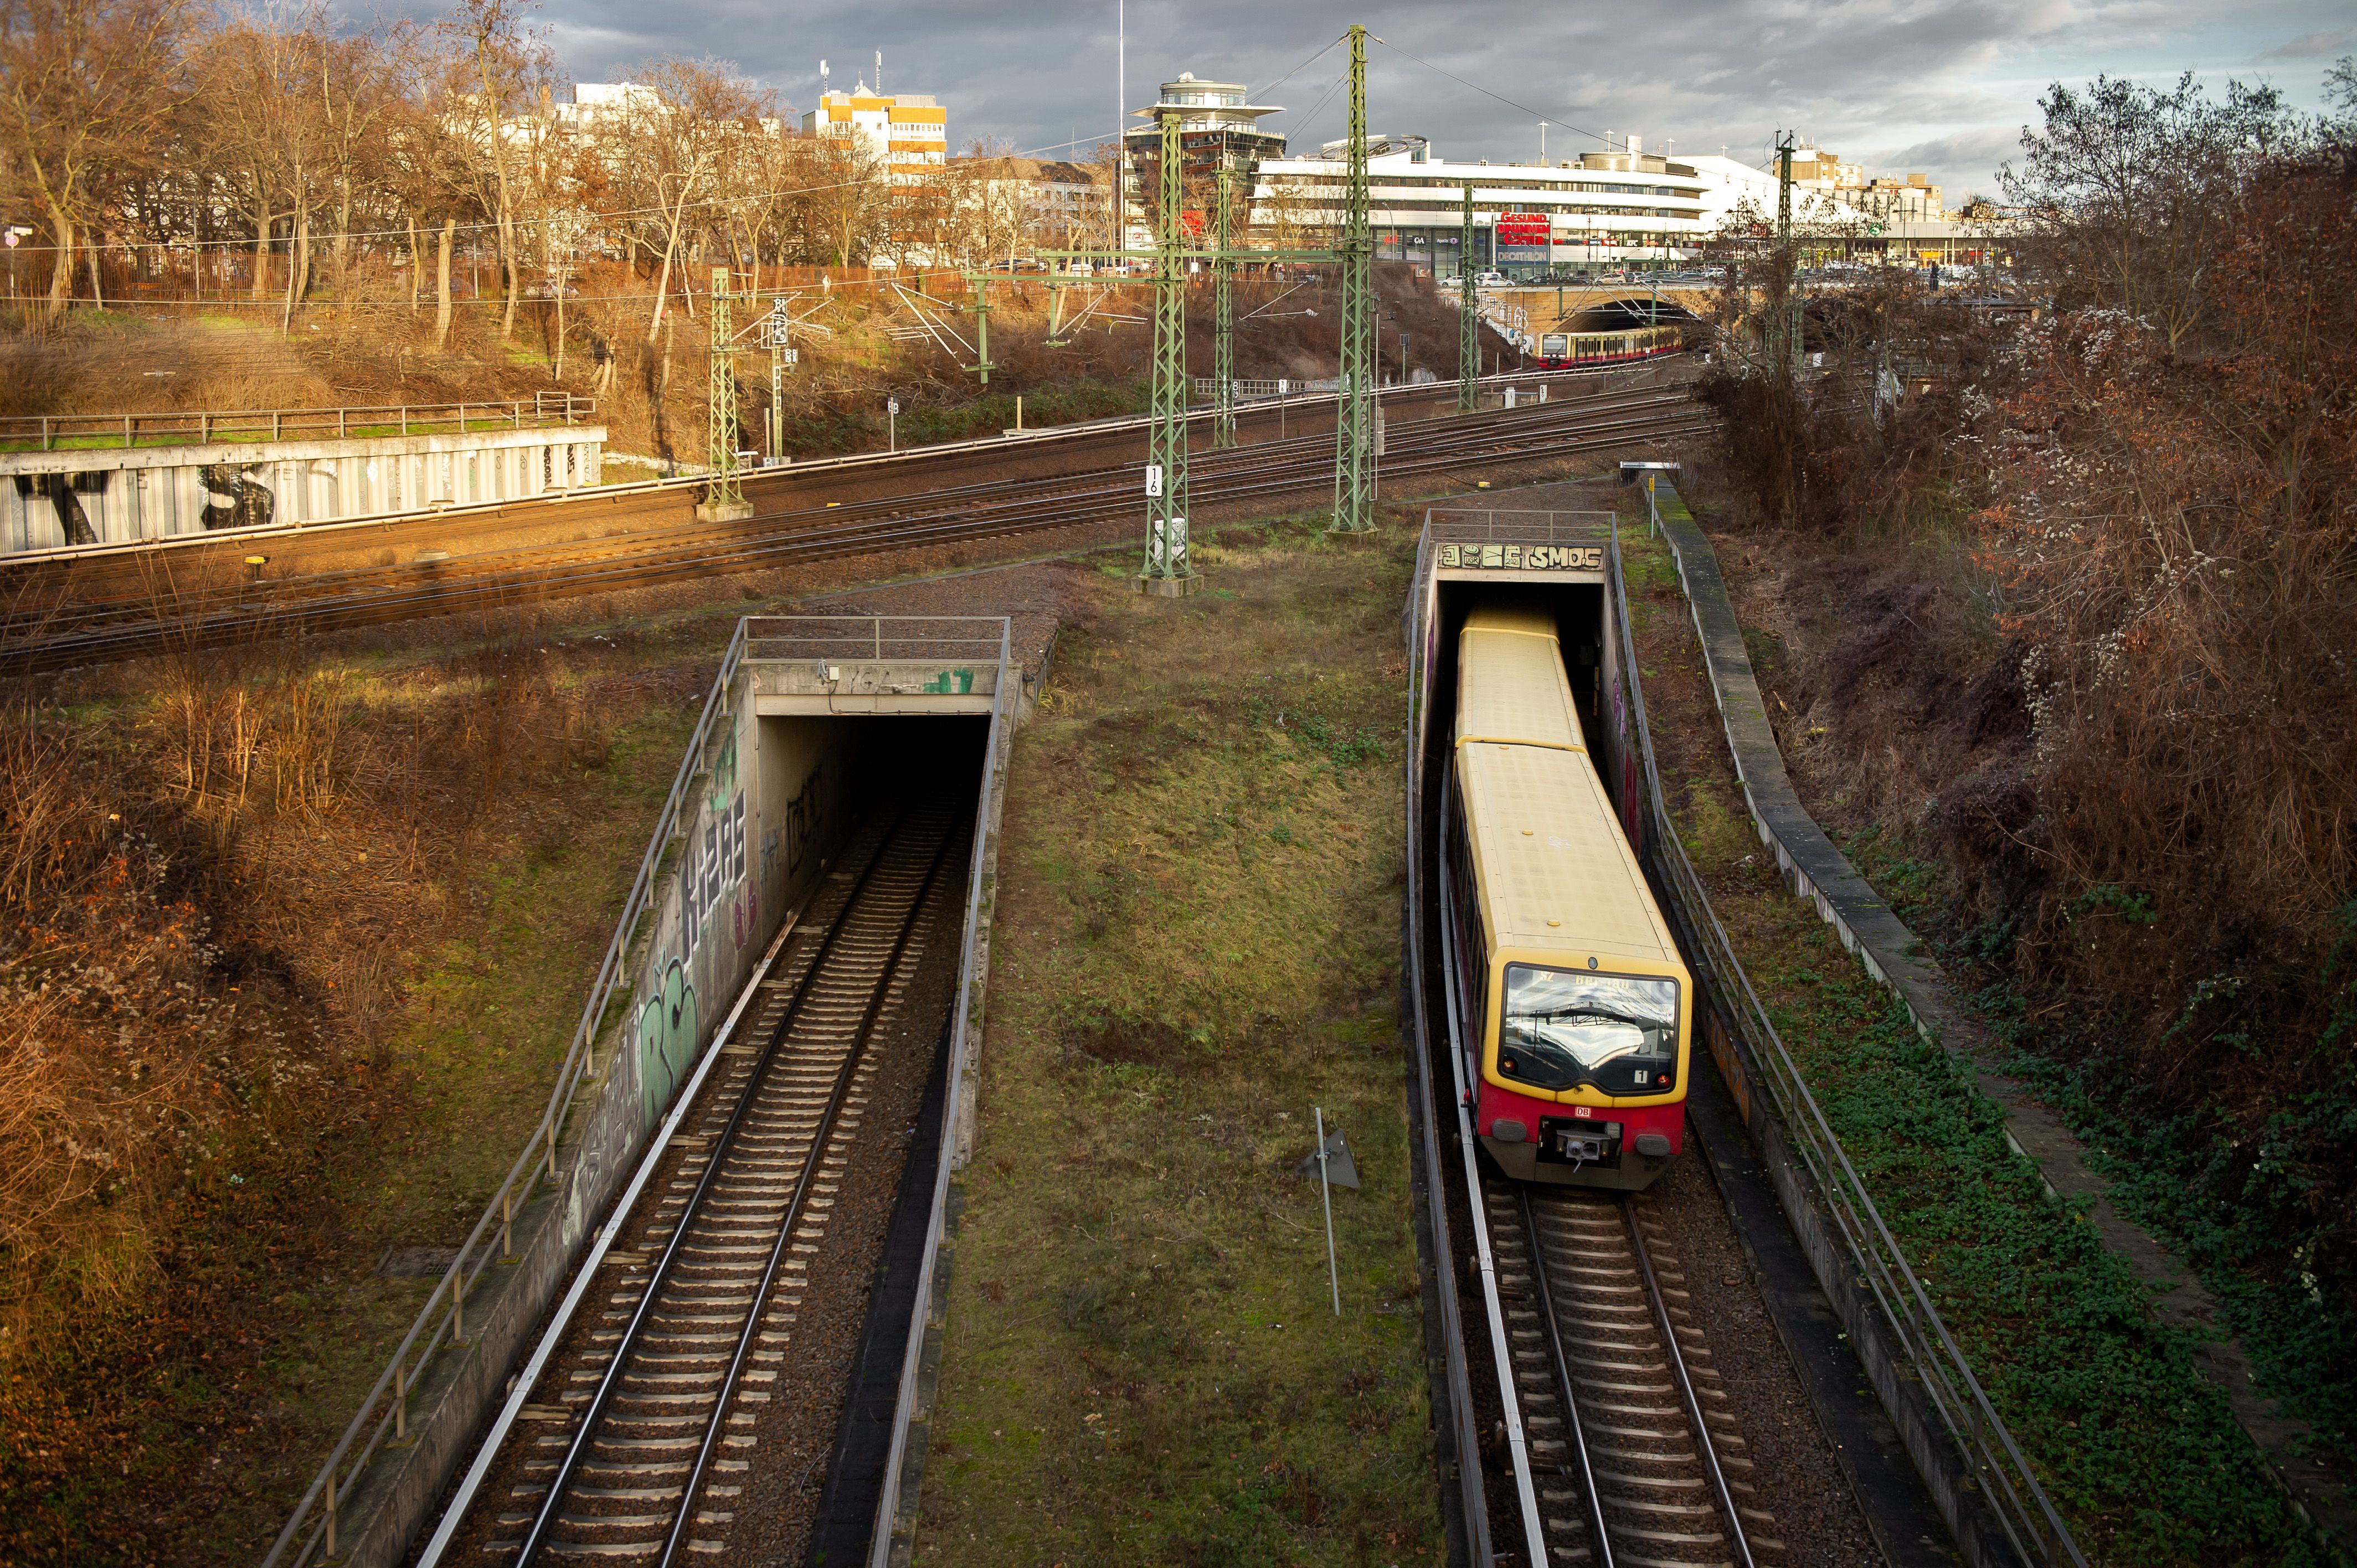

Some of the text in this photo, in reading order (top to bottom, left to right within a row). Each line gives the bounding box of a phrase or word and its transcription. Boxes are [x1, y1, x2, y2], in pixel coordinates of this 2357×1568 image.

[1497, 224, 1550, 233] BRUNNEN
[1498, 251, 1546, 261] DECATHLON
[1152, 468, 1156, 479] 1
[1151, 481, 1157, 492] 6
[1576, 975, 1630, 989] Berau
[1639, 1070, 1644, 1081] 1
[1577, 1108, 1589, 1116] DB
